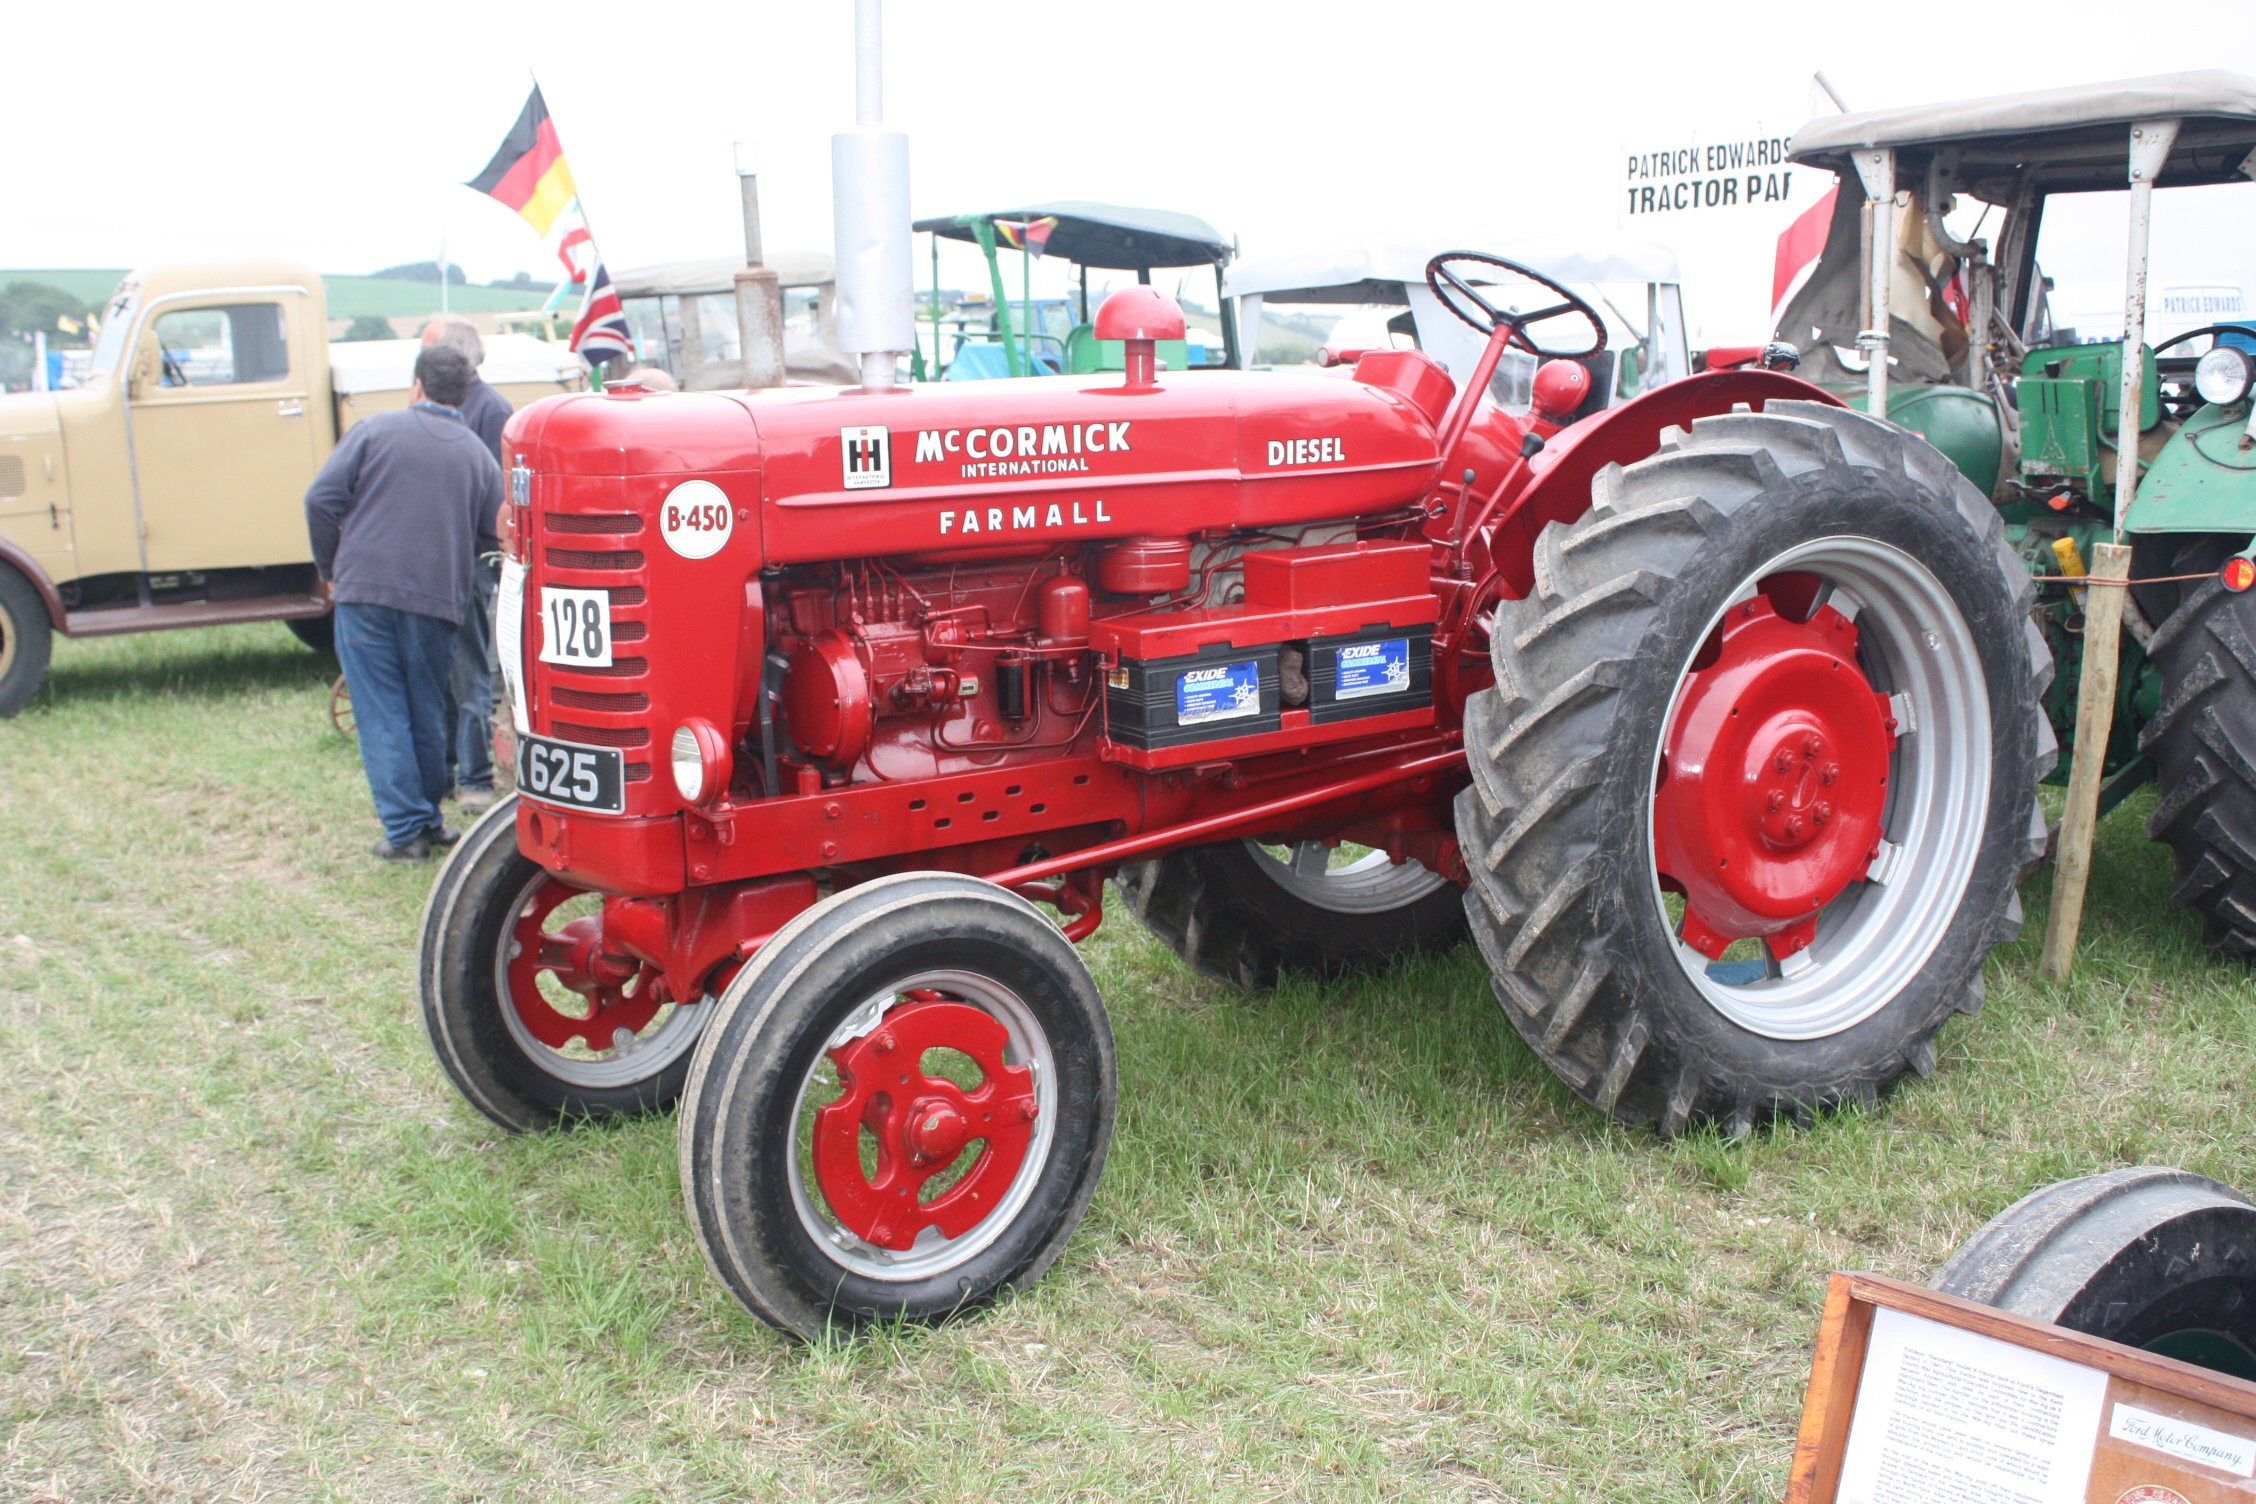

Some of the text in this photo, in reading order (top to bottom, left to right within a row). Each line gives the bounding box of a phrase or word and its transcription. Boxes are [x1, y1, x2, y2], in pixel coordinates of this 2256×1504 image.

[1628, 147, 1700, 180] PATRICK
[1628, 177, 1738, 214] TRACTOR
[2164, 295, 2241, 313] PATRICK EDWARDS
[1267, 437, 1346, 467] DIESEL
[961, 458, 1089, 478] INTERNATIONAL
[939, 499, 1111, 535] FARMALL
[549, 598, 604, 660] 128
[1342, 644, 1381, 659] EXIDE
[1184, 667, 1228, 683] EXIDE
[531, 744, 598, 802] 625
[2122, 1417, 2151, 1440] Ford
[2152, 1427, 2183, 1447] Motor
